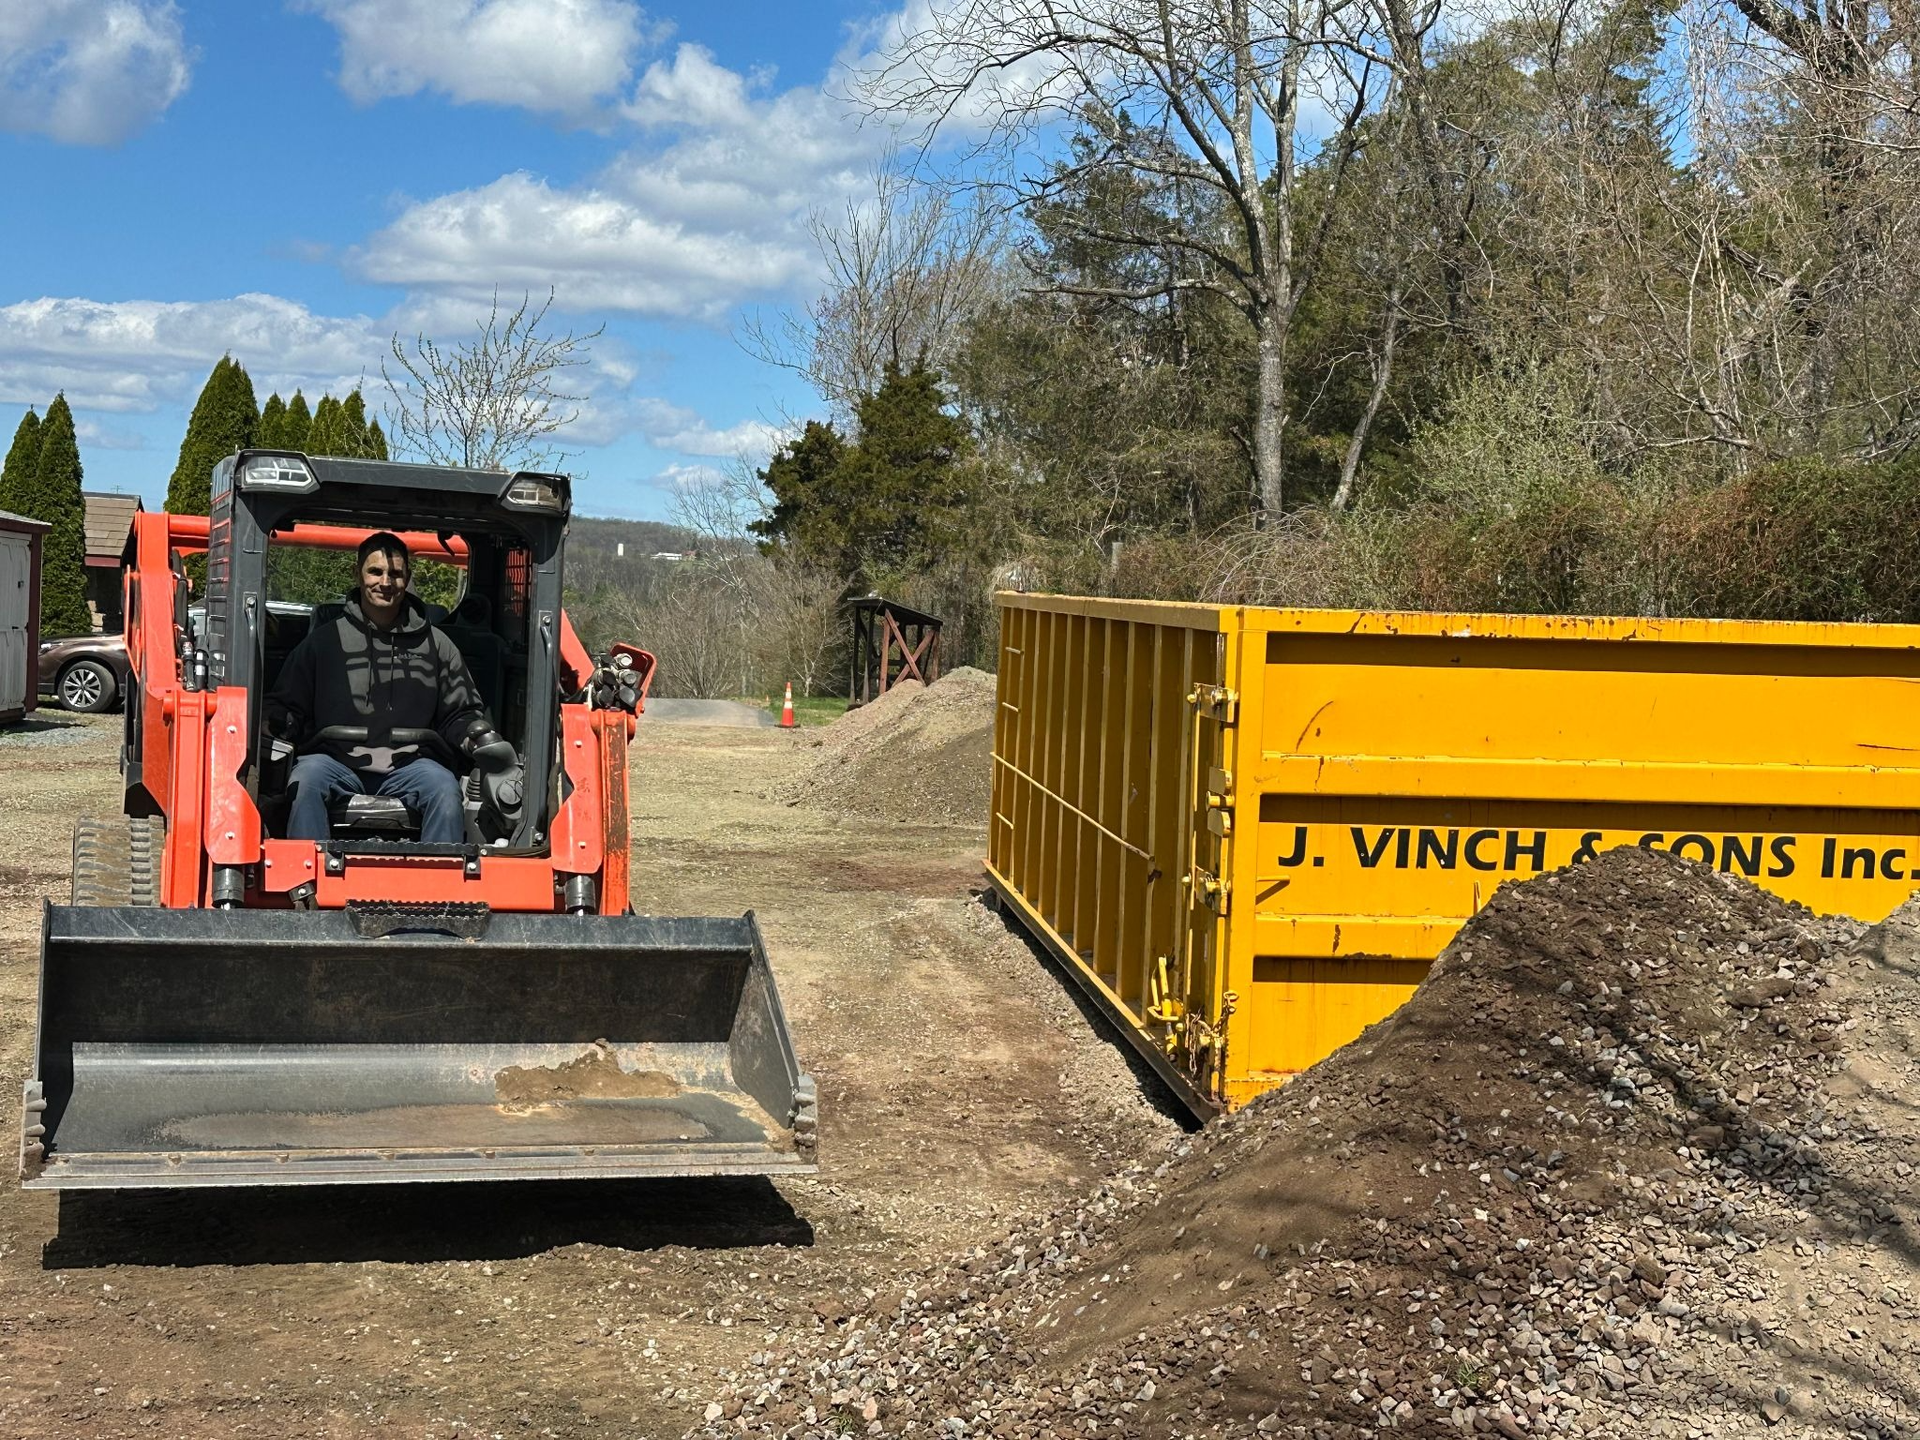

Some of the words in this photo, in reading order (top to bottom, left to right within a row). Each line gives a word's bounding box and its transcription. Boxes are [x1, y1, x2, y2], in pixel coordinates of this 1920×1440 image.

[1278, 826, 1324, 868] J.
[1350, 827, 1547, 871] VINCH
[1571, 832, 1602, 865] &
[1821, 838, 1920, 880] Inc.
